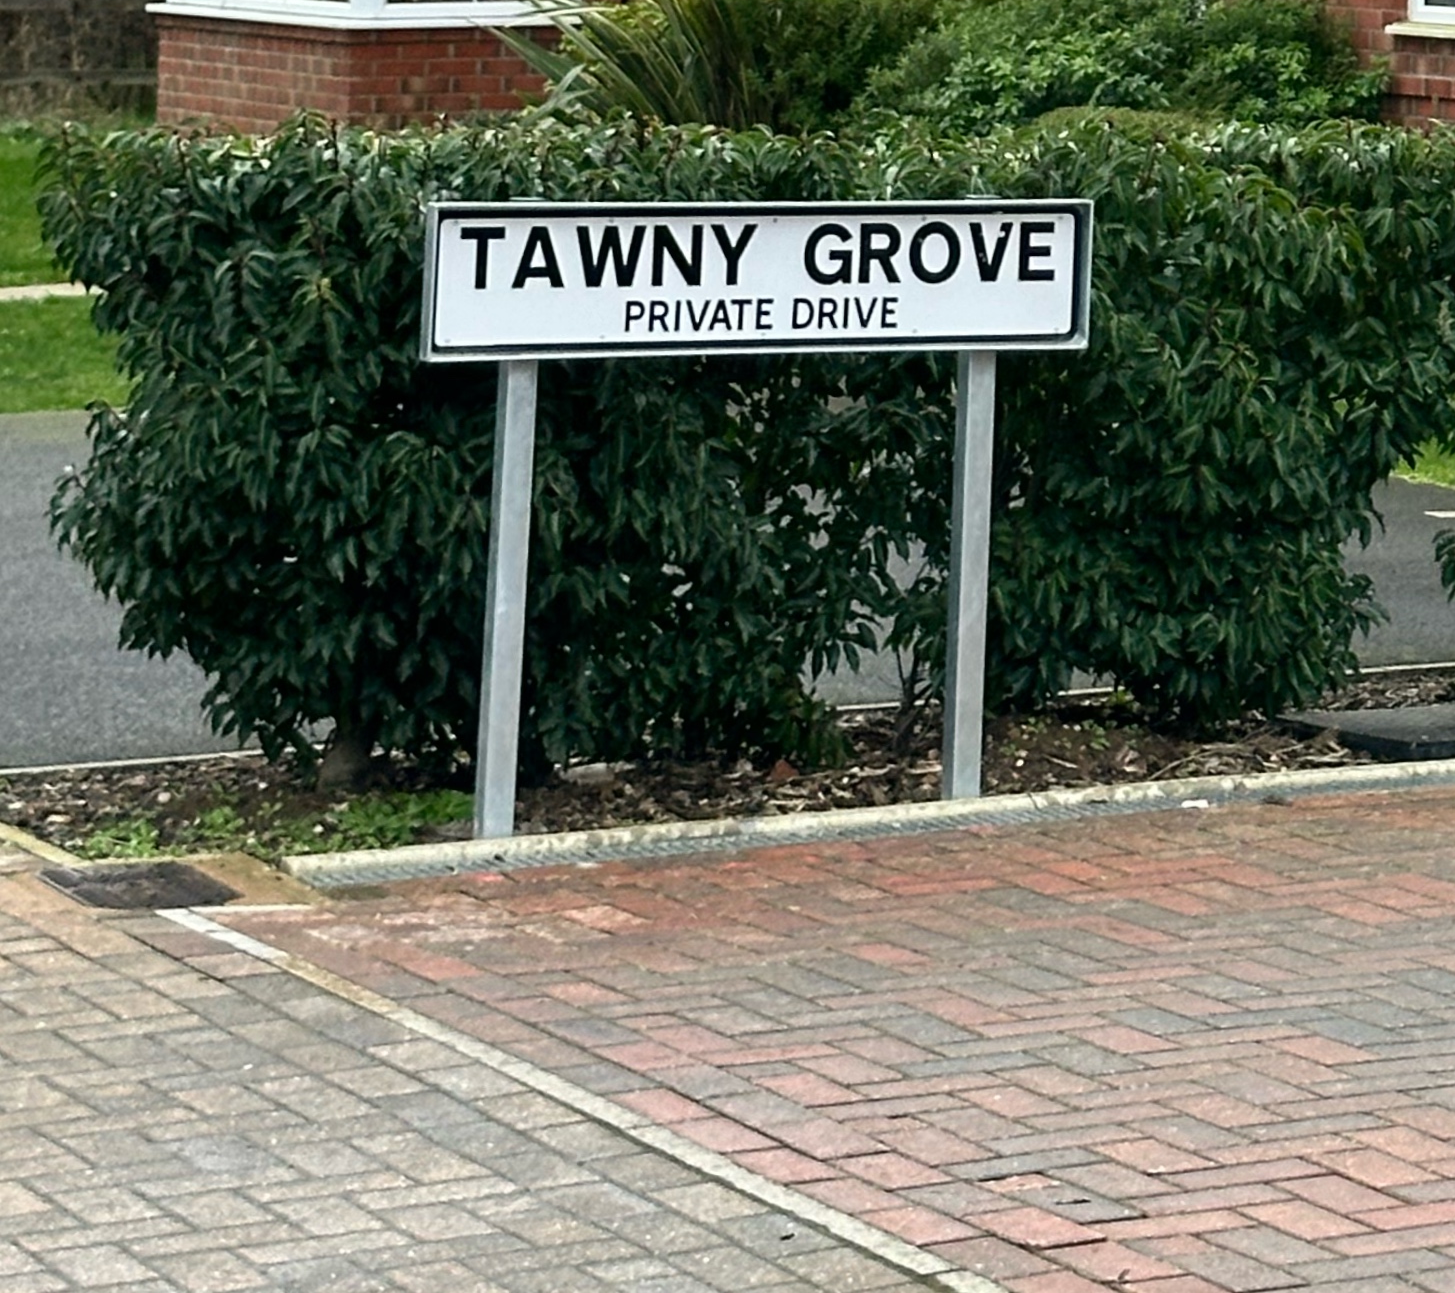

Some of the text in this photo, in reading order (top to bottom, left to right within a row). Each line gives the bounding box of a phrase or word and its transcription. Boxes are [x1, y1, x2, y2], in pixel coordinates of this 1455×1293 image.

[460, 221, 1056, 290] TAWNY GROVE
[624, 297, 898, 332] PRIVATE DRIVE
